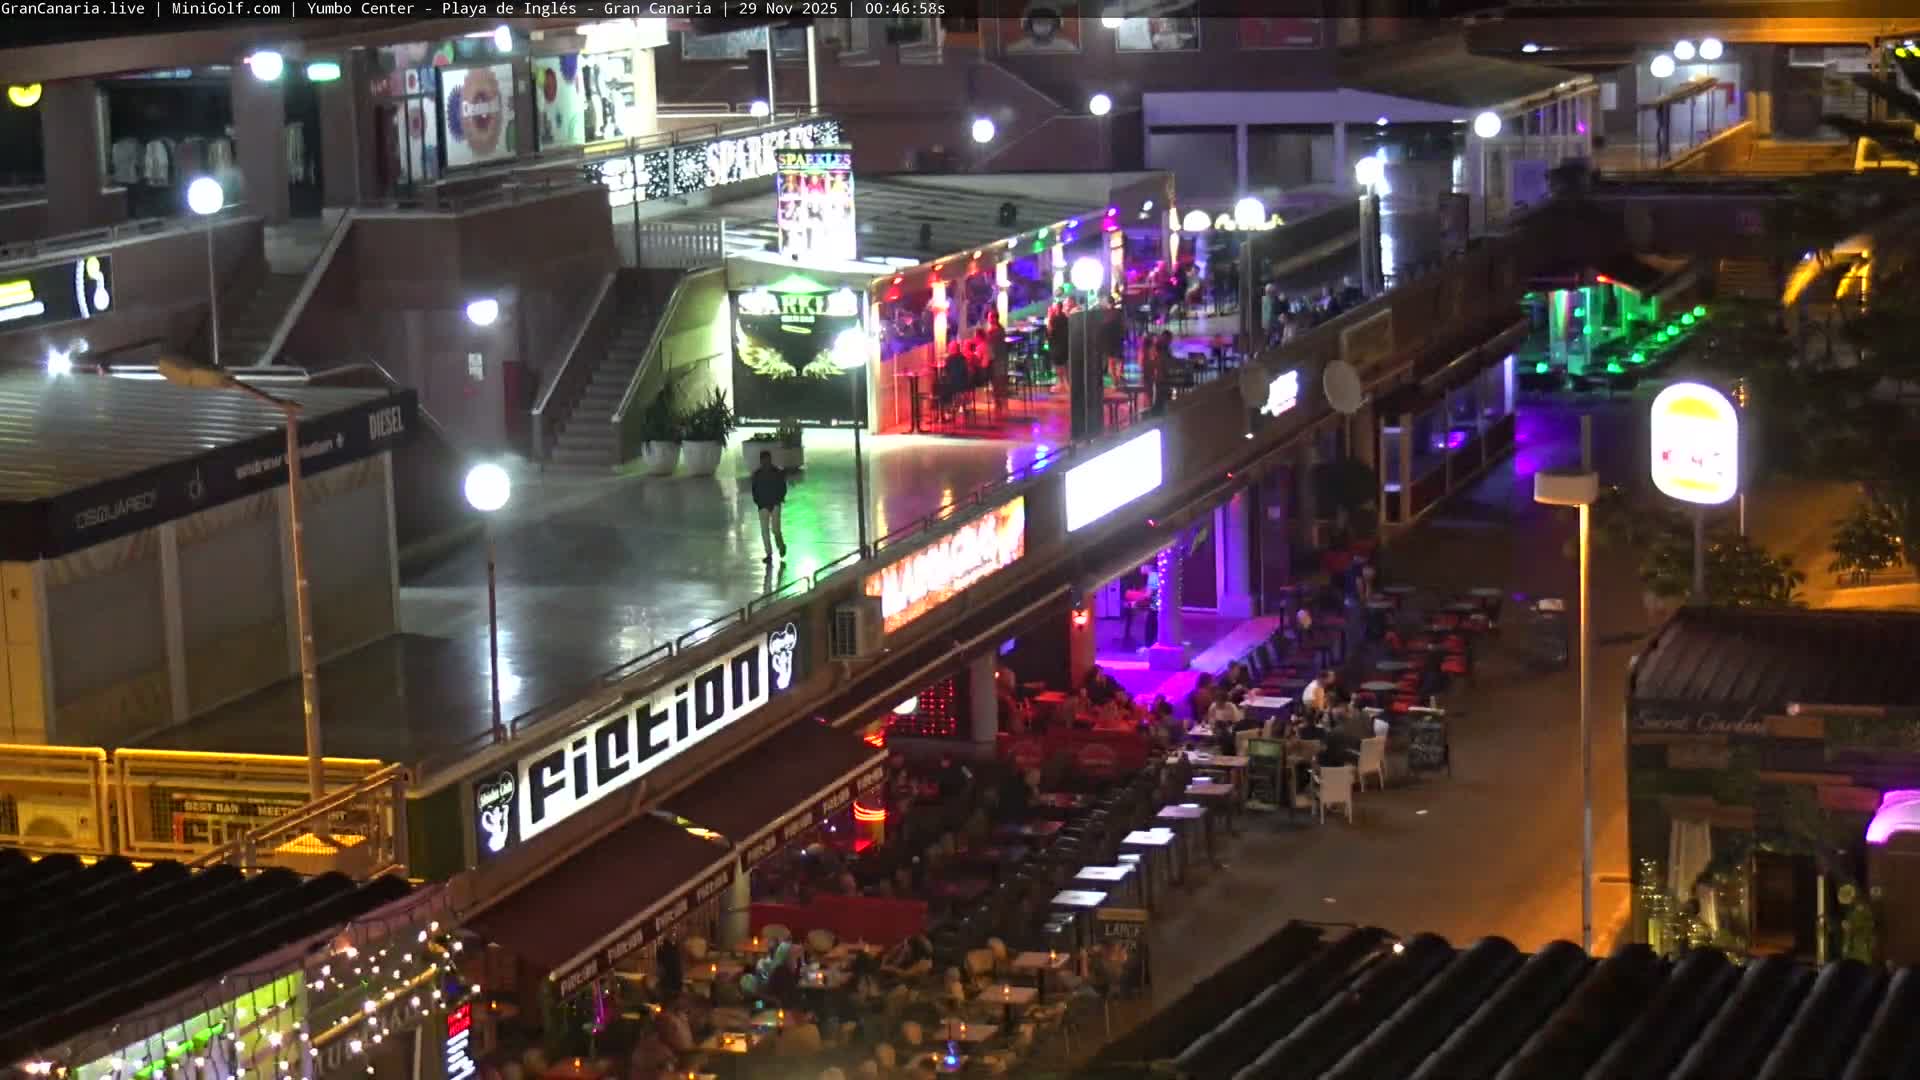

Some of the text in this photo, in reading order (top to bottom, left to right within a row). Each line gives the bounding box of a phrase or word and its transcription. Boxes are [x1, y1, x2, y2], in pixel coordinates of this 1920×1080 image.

[778, 151, 852, 167] SPARKLES
[738, 294, 858, 315] SPARKL
[369, 406, 404, 440] DIESEL
